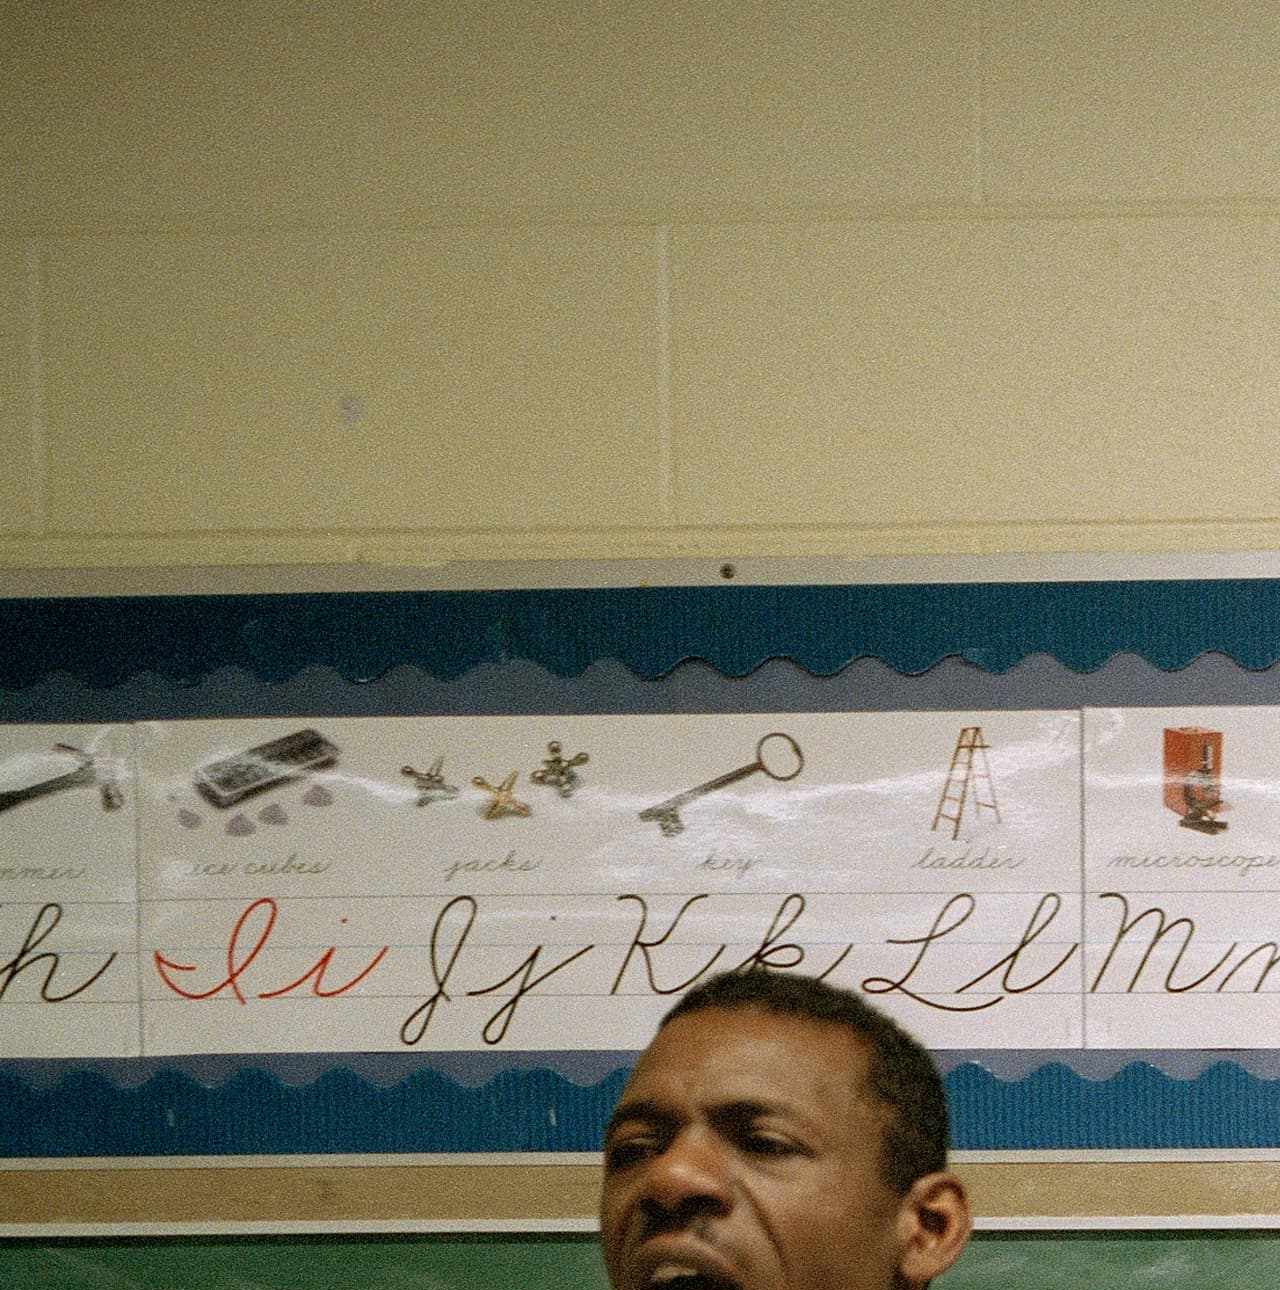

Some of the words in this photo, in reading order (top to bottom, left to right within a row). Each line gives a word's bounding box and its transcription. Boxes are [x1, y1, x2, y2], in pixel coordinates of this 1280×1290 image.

[444, 853, 543, 880] jacks
[698, 849, 760, 880] key
[911, 848, 1028, 870] ladder
